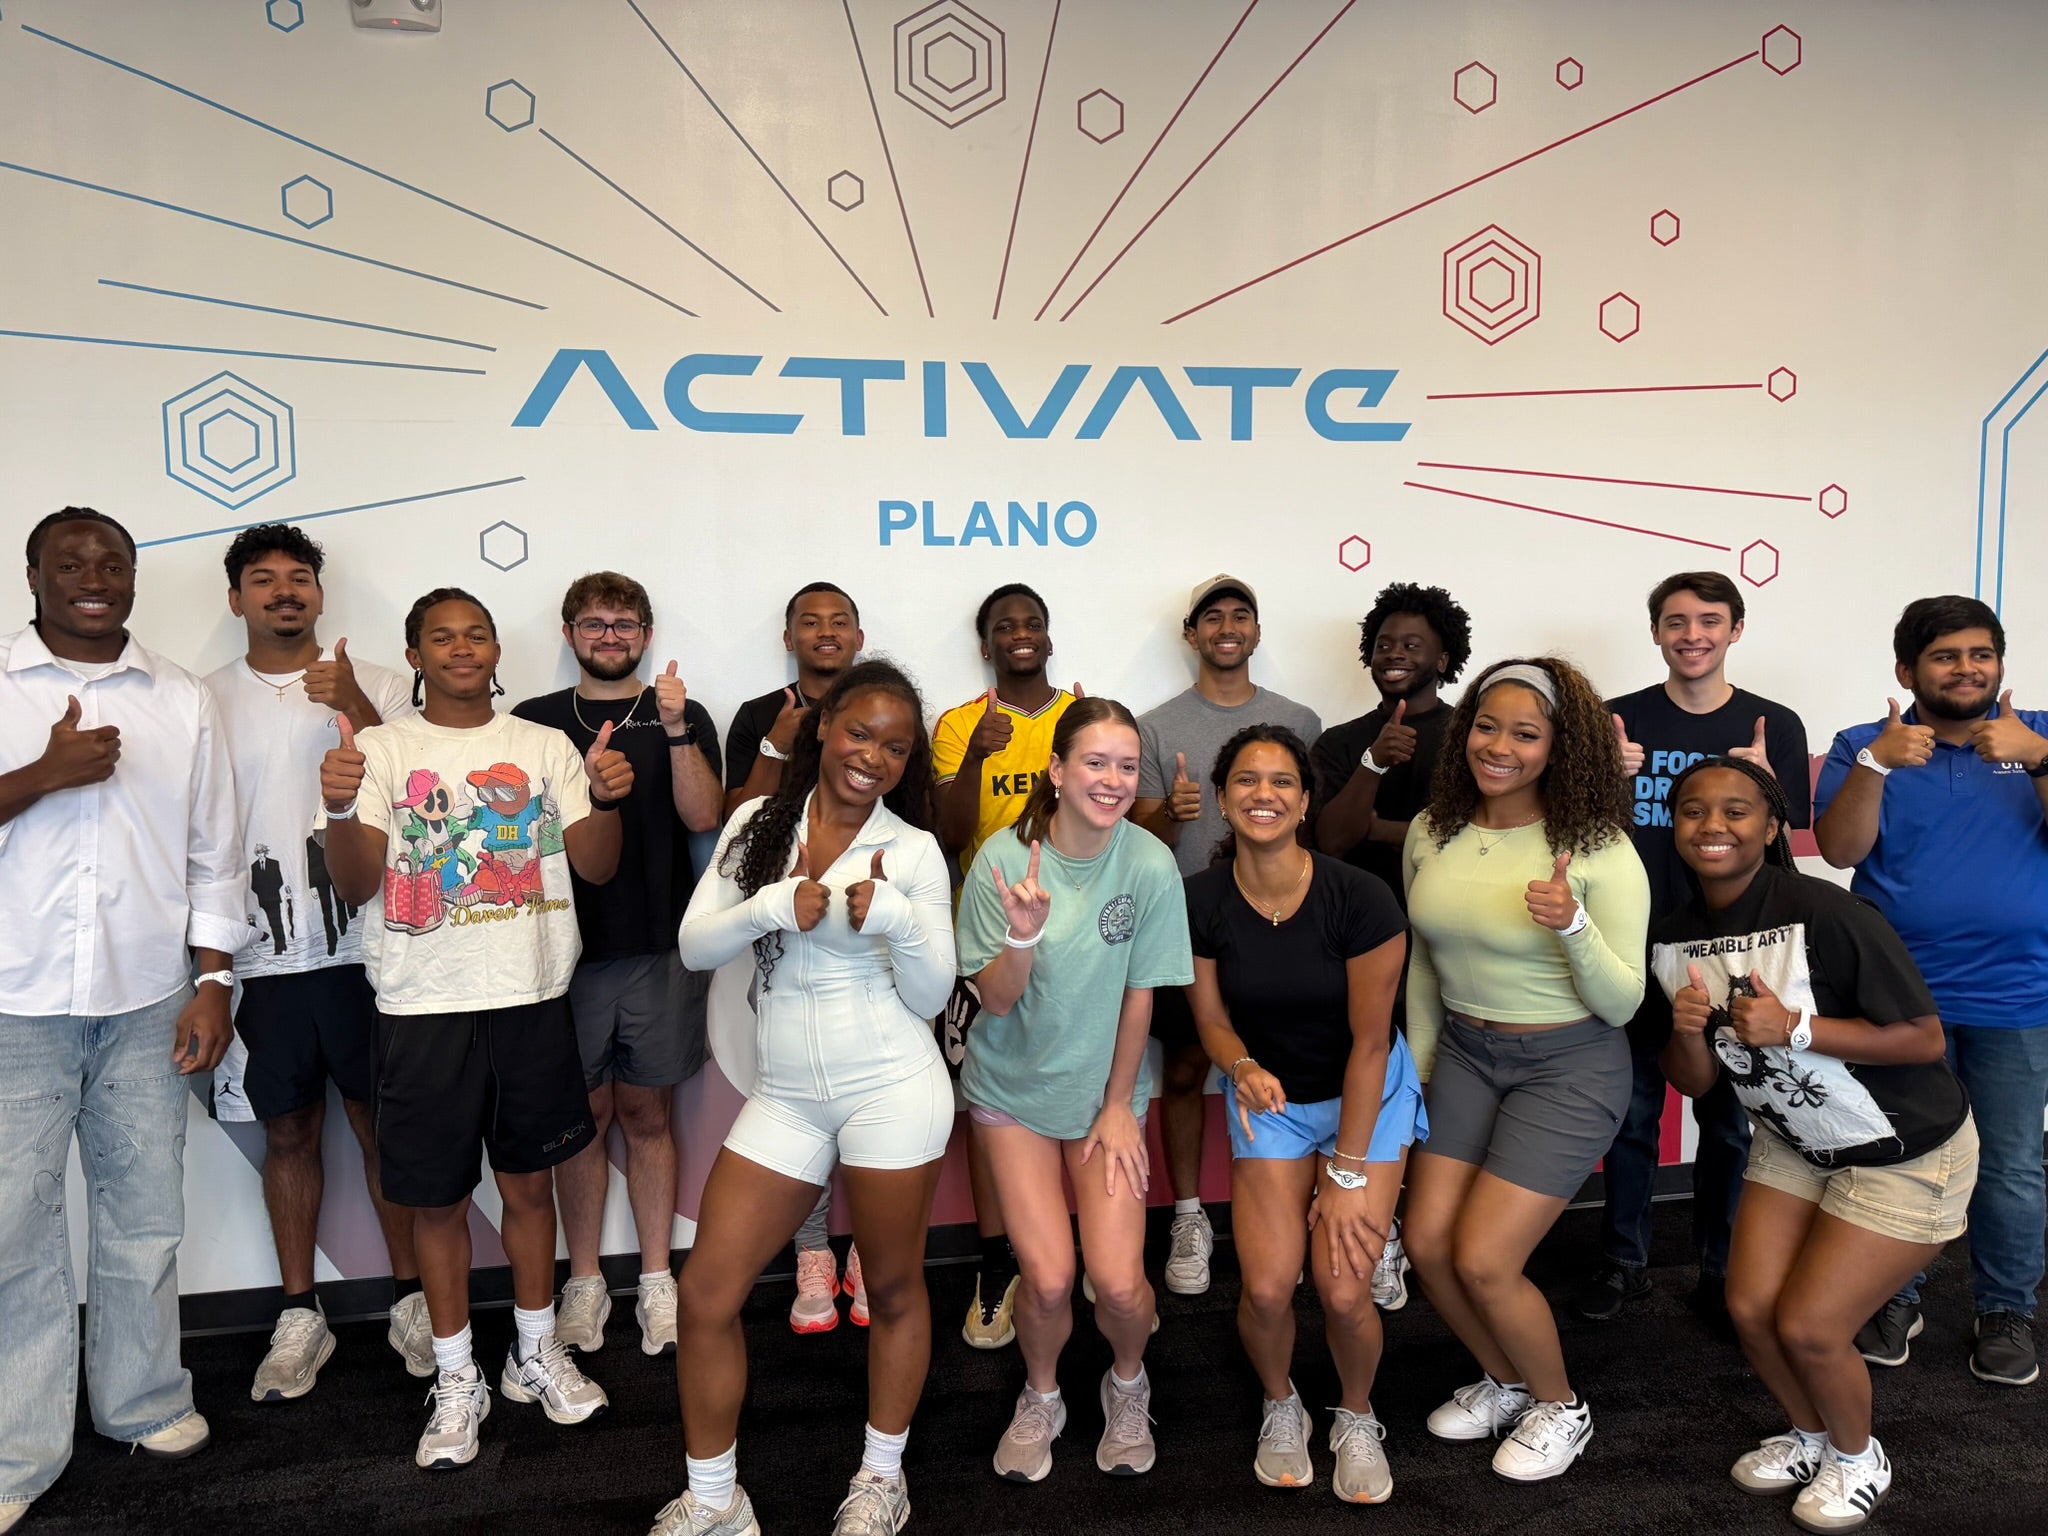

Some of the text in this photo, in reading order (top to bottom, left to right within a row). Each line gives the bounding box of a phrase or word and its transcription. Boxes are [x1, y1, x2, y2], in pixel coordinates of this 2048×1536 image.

[510, 348, 1413, 441] ACTIVATE
[878, 500, 1097, 547] PLANO
[992, 770, 1044, 797] KEN
[1635, 776, 1673, 801] DR
[1633, 802, 1674, 828] SM
[496, 825, 519, 841] DH
[448, 905, 519, 928] Daven
